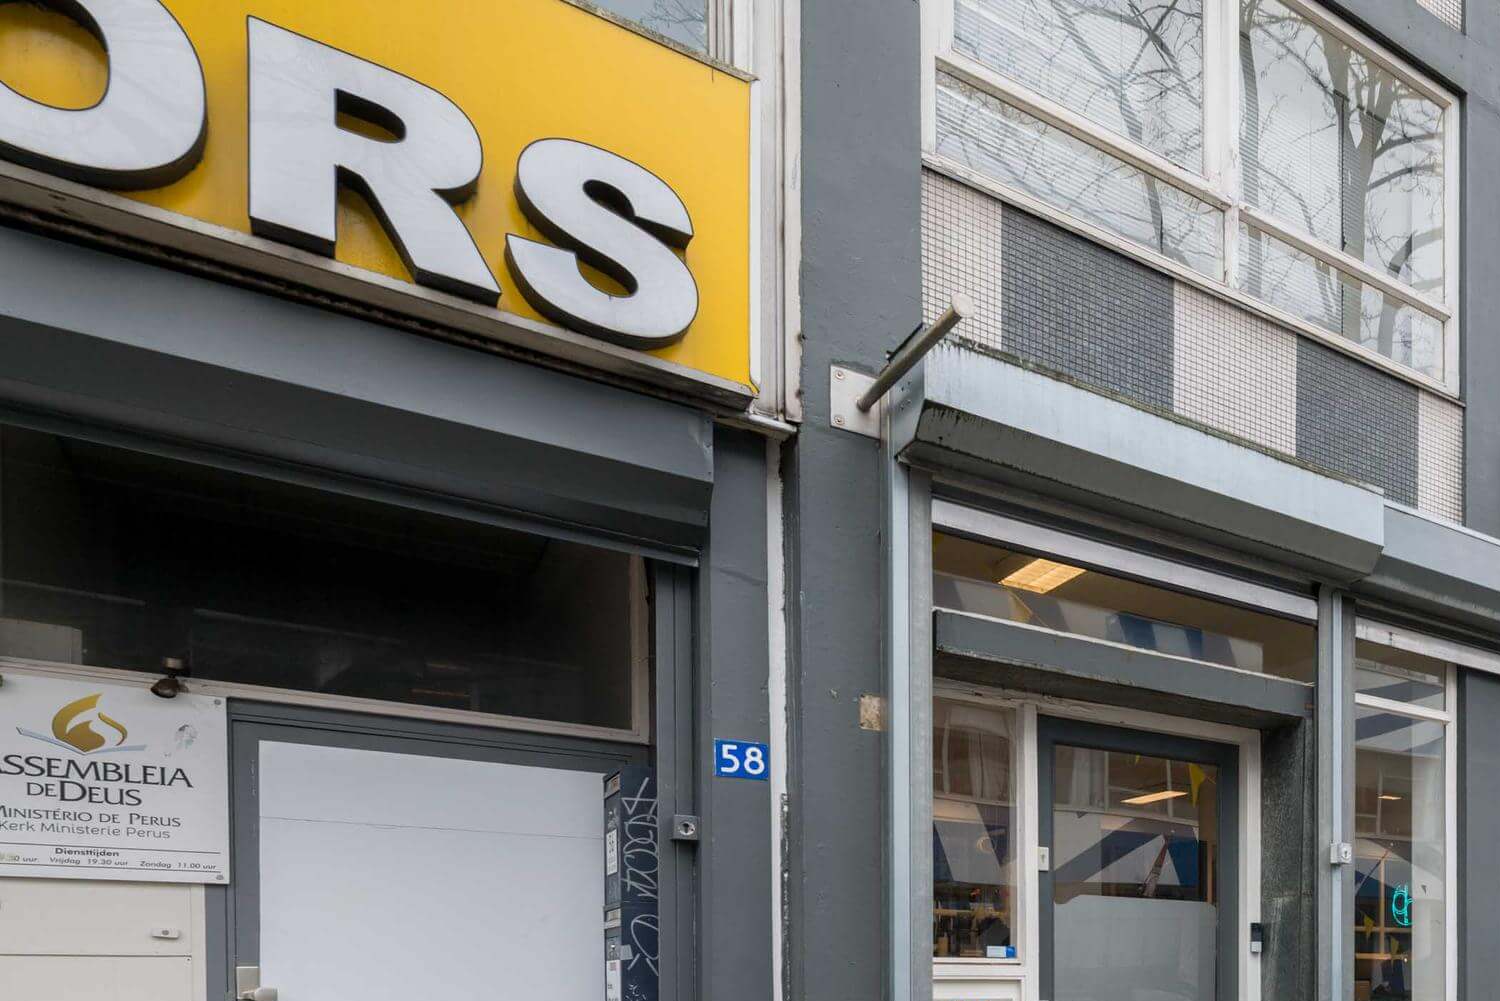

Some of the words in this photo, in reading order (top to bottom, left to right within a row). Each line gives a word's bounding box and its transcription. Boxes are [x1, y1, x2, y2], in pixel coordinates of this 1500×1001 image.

[0, 0, 699, 350] ORS
[720, 743, 765, 775] 58
[0, 754, 194, 788] SSEMBLEIA
[0, 819, 36, 832] Kerk
[40, 820, 121, 837] Ministerie
[126, 826, 171, 840] Perus
[99, 812, 121, 824] DE
[129, 813, 182, 828] PERUS
[49, 856, 81, 865] Vrijdag
[140, 860, 172, 869] Zondag
[55, 847, 120, 857] Diensttijden
